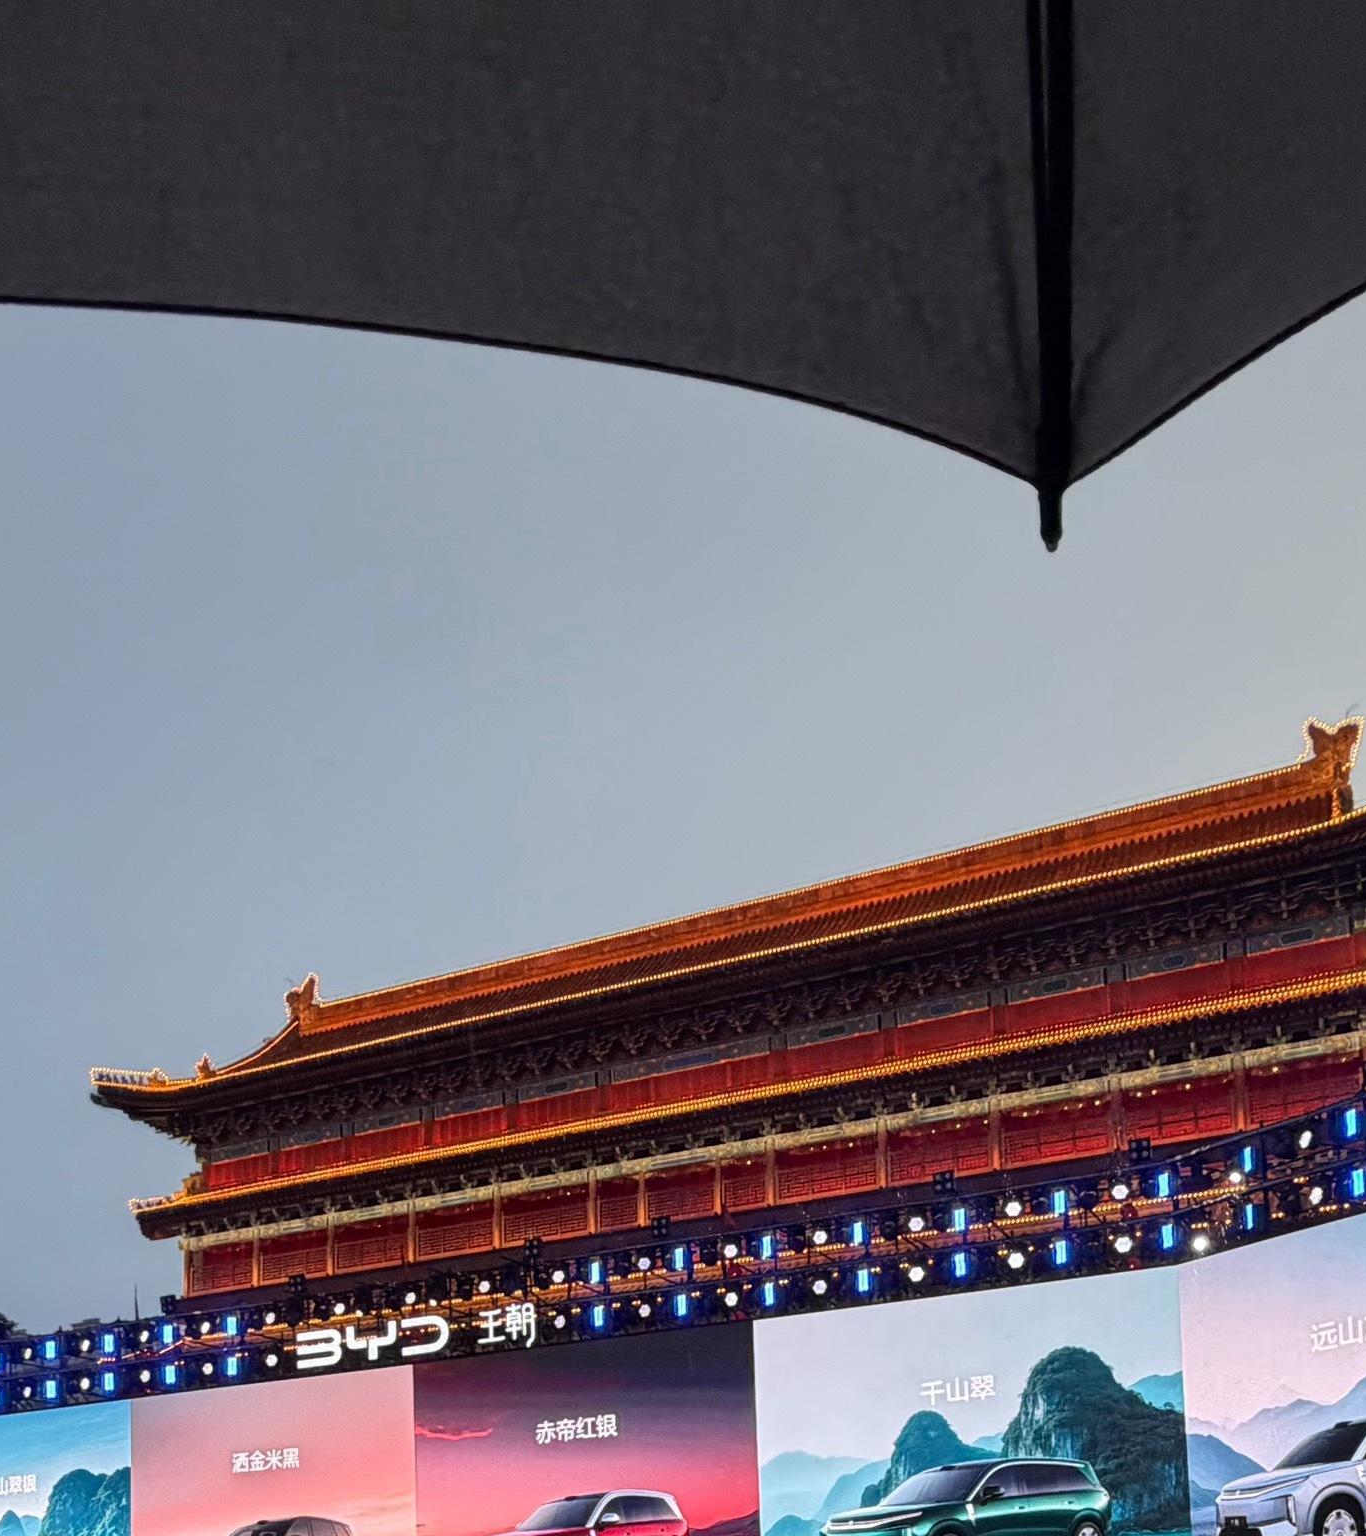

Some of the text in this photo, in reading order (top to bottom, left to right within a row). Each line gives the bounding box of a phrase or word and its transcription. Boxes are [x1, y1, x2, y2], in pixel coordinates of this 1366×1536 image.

[295, 1302, 537, 1370] BYD 王朝
[920, 1374, 996, 1406] 千山翠
[535, 1413, 619, 1445] 赤帝红银
